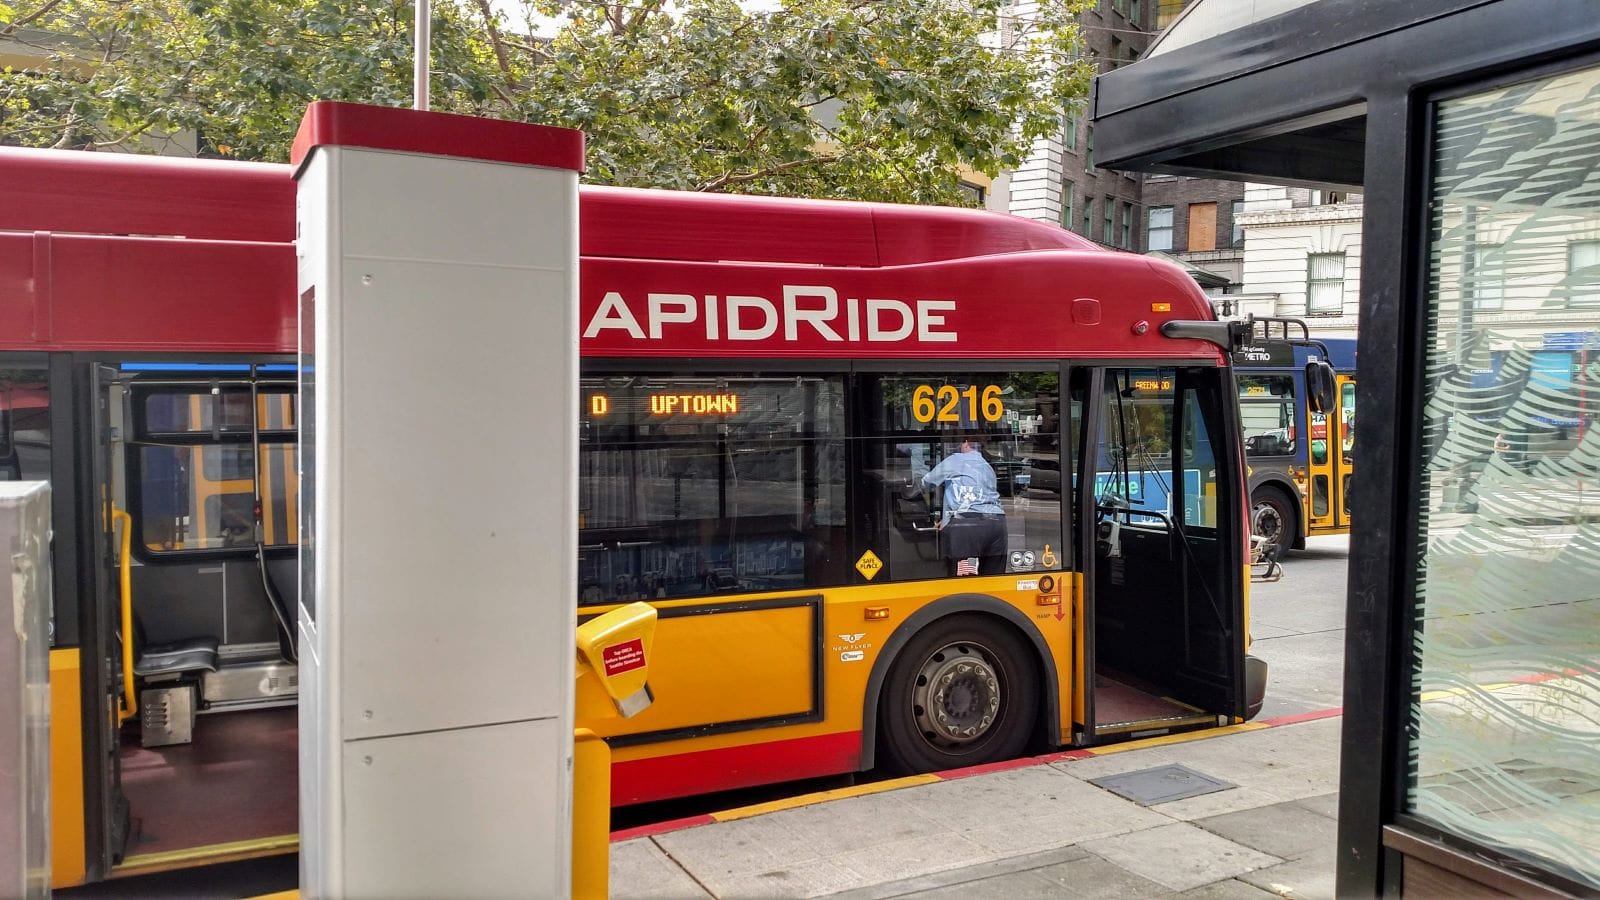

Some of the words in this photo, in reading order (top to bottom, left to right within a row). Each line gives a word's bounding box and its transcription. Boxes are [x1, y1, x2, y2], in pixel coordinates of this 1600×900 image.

[592, 395, 608, 414] D
[651, 394, 738, 414] UPTOWN
[912, 385, 1004, 423] 6216
